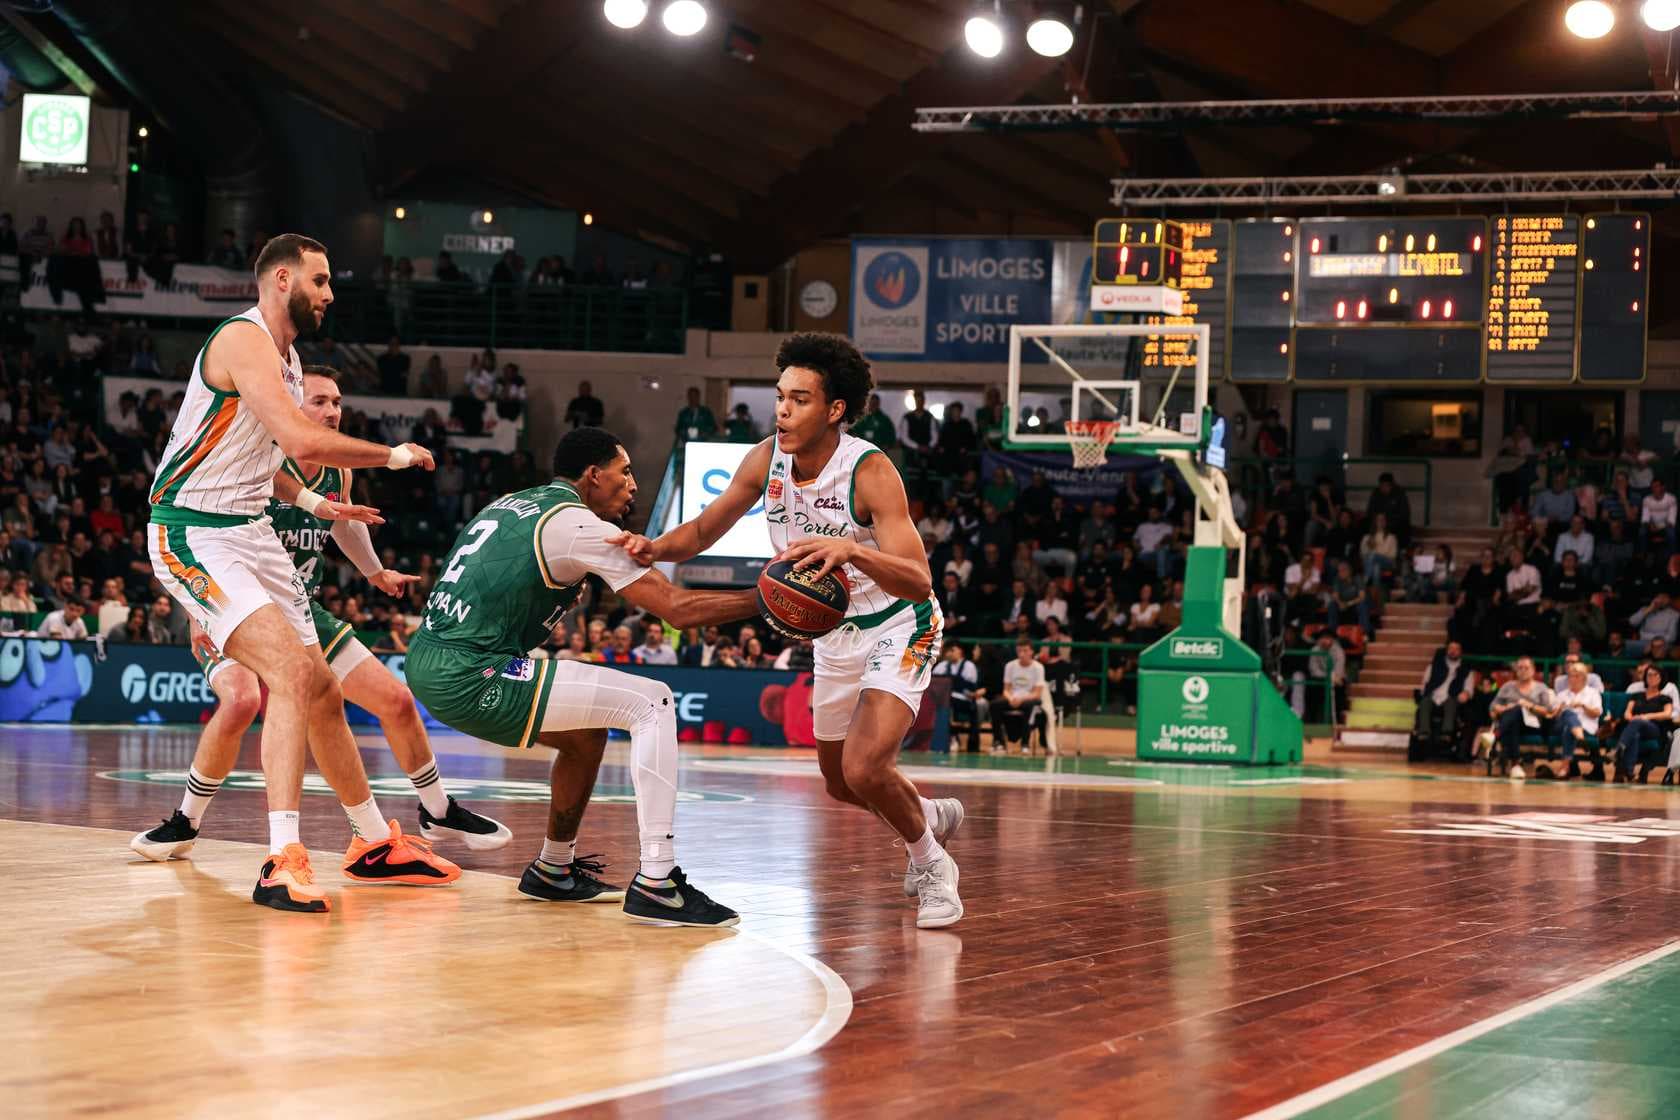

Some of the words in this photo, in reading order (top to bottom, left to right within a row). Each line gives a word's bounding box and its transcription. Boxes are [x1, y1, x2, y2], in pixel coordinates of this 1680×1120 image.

[936, 257, 1045, 280] LIMOGES
[960, 294, 1019, 315] VILLE
[935, 323, 1010, 344] SPORT
[814, 497, 844, 511] Chais
[767, 504, 791, 524] Le
[795, 512, 848, 537] Portel
[440, 520, 498, 584] 2
[1174, 641, 1218, 655] Betclic
[1161, 724, 1228, 740] LIMOGES
[1151, 739, 1179, 752] ville
[1182, 741, 1237, 755] sportive
